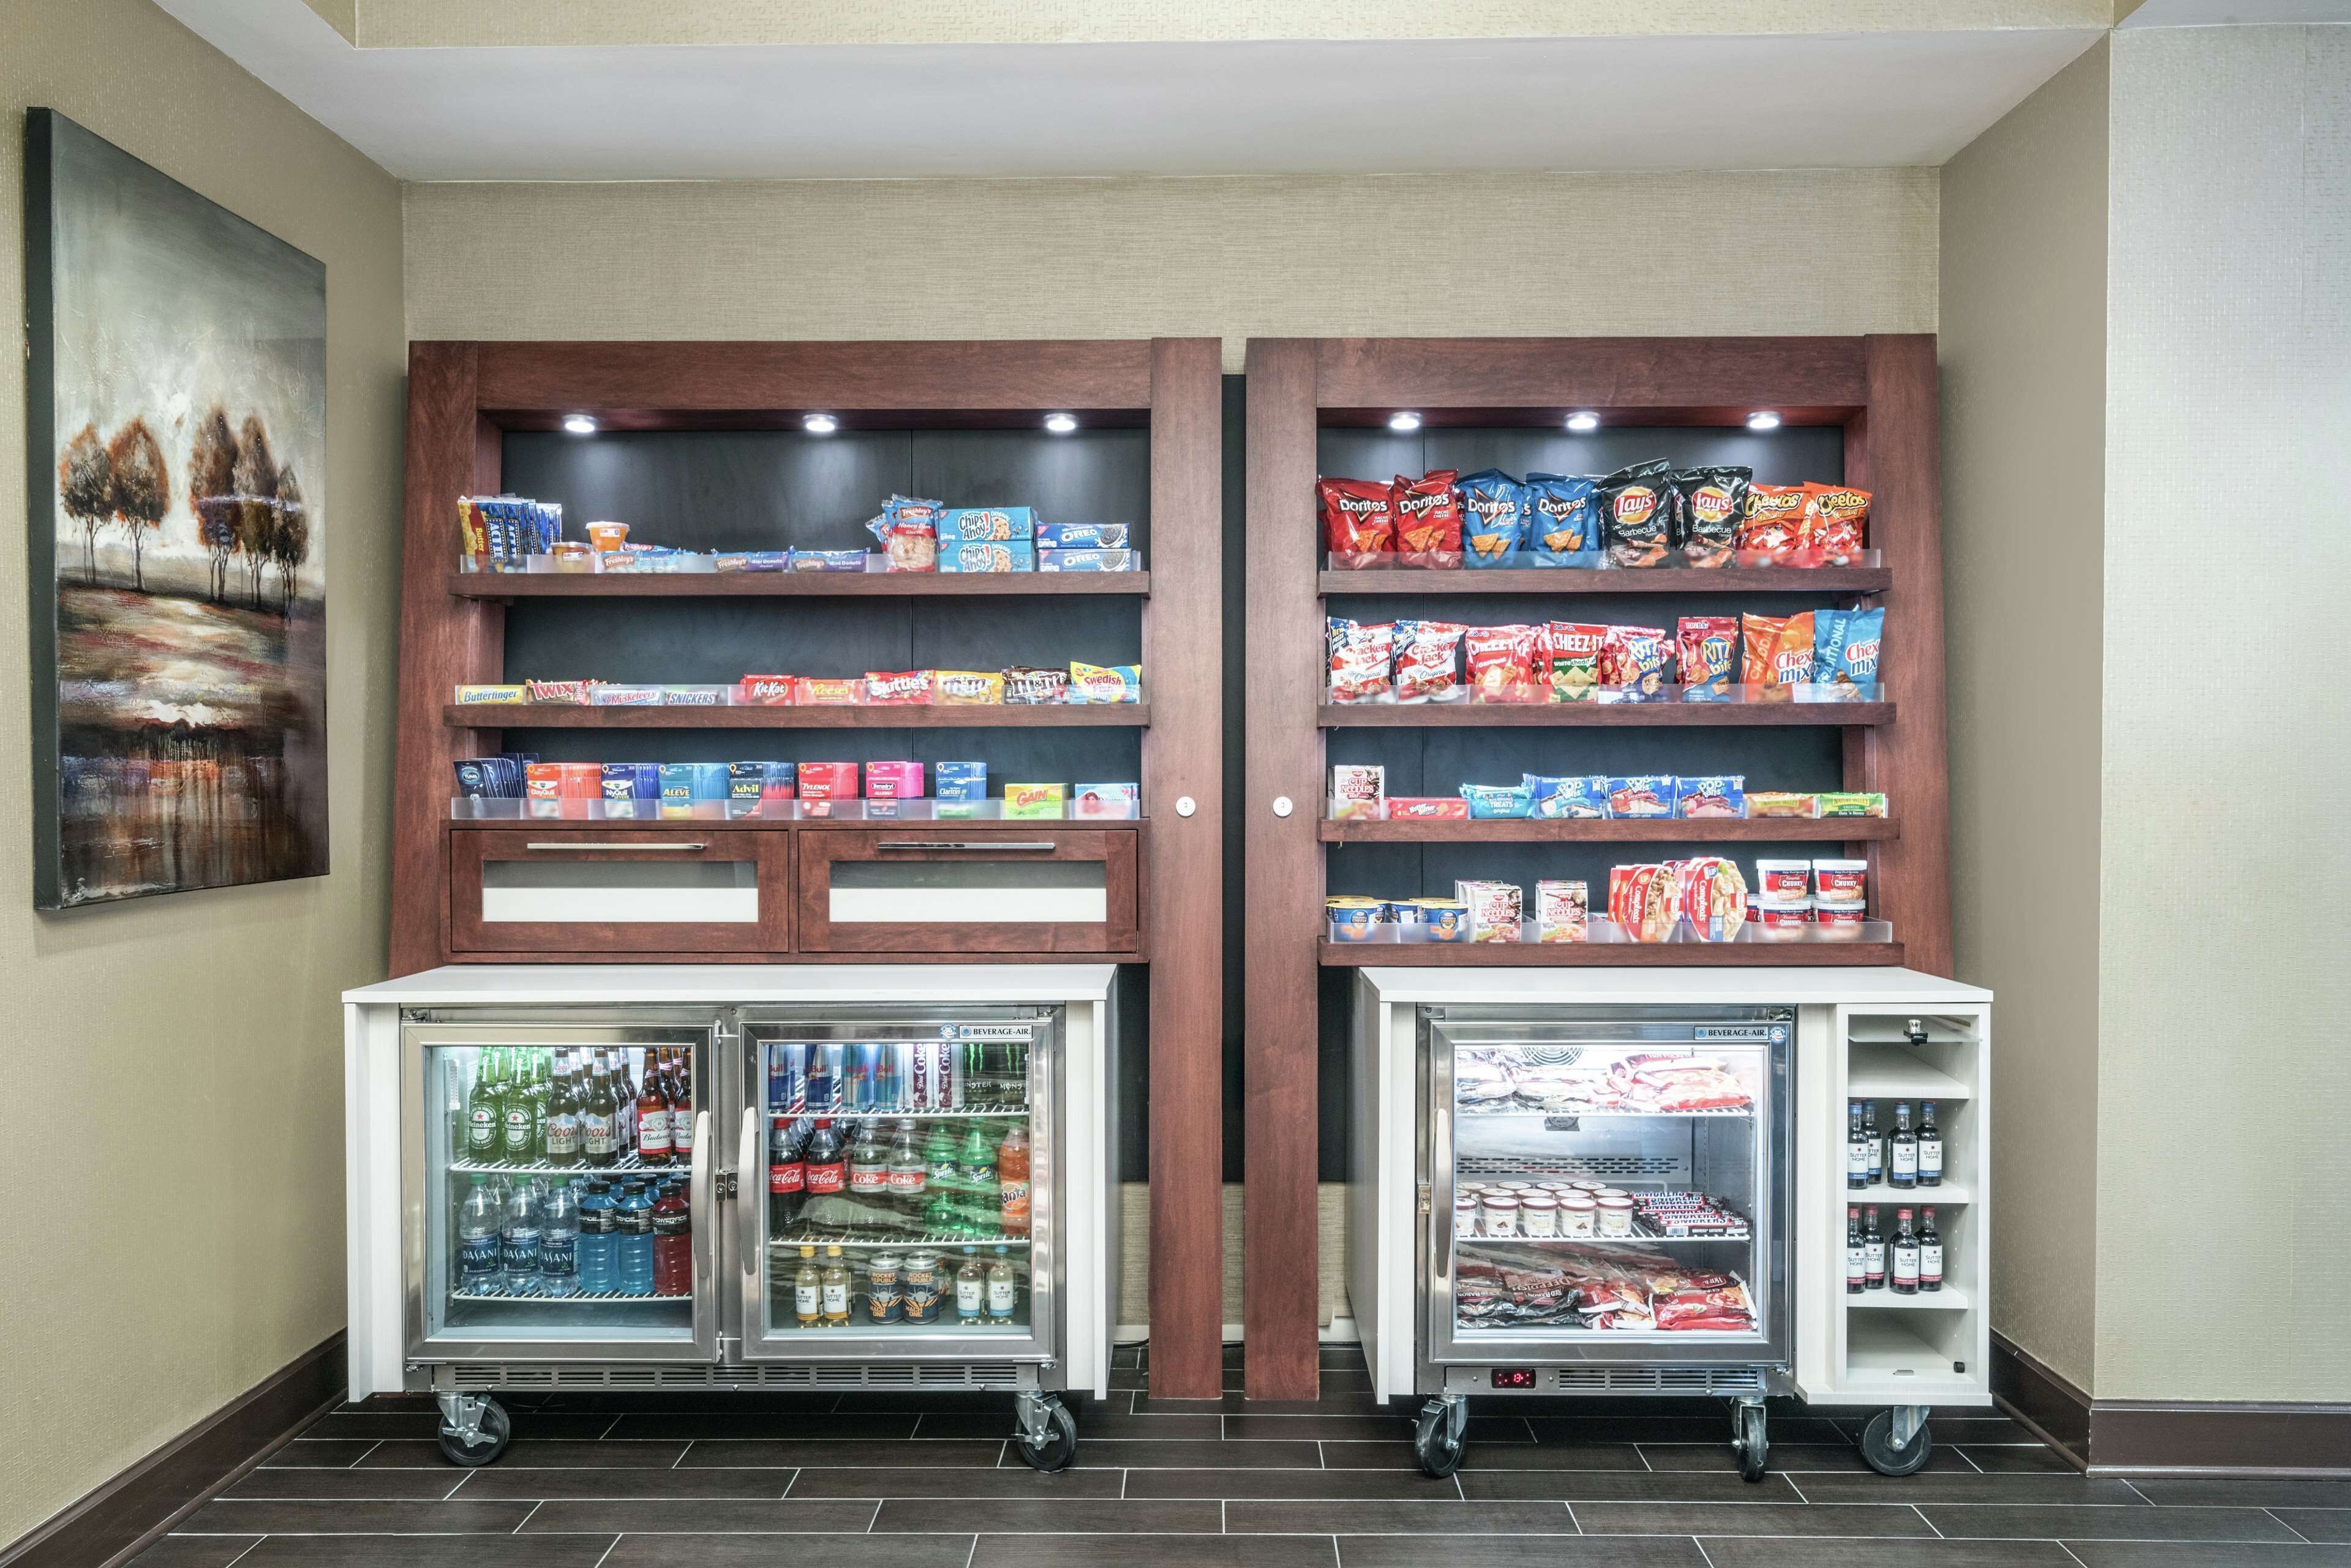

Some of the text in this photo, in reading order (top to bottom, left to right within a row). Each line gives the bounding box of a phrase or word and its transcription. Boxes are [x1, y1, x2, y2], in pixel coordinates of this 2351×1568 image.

[1339, 498, 1388, 512] Doritos
[1399, 493, 1450, 514] Doritos
[1467, 498, 1516, 513] Doritos
[1538, 497, 1586, 512] Doritos
[1618, 492, 1653, 516] Lay's
[1696, 492, 1730, 512] Lay's
[1745, 492, 1801, 518] Cheetos
[1818, 490, 1867, 516] Cheetos
[959, 513, 984, 531] Chips
[1060, 528, 1097, 543] OREO
[1619, 525, 1657, 538] Barbecue
[1692, 525, 1732, 534] Barbecue
[475, 528, 484, 552] Butter
[959, 546, 984, 563] Chips
[1063, 553, 1100, 568] OREO
[1702, 641, 1731, 663] RITZ
[1846, 639, 1881, 662] Chex
[1418, 652, 1444, 666] Jack
[1776, 649, 1813, 669] Chex
[1851, 655, 1878, 675] mix
[1709, 659, 1732, 675] bits
[1778, 664, 1811, 683] mix
[1083, 673, 1122, 686] Swedish
[1354, 670, 1382, 682] Original
[870, 675, 930, 697] Skittles
[464, 690, 519, 703] Butterfinger
[612, 690, 656, 704] Musketeers
[669, 692, 716, 705] SNICKERS
[662, 788, 690, 797] ALEVE
[732, 784, 759, 793] Advil
[939, 787, 961, 795] Claritin
[1340, 785, 1374, 795] NOODLES
[1016, 789, 1048, 807] GAIN
[1489, 901, 1509, 910] CUP
[1554, 901, 1574, 909] CUP
[1481, 909, 1516, 917] NOODLES
[1546, 908, 1581, 917] NOODLES
[914, 1043, 927, 1075] Coke
[939, 1043, 950, 1075] Coke
[878, 1065, 895, 1073] Bull
[853, 1173, 878, 1184] Coke
[890, 1174, 916, 1185] Coke
[933, 1167, 954, 1180] Sprite
[971, 1169, 992, 1183] Sprite
[463, 1247, 497, 1262] DASANI
[504, 1247, 537, 1261] DASANI
[541, 1251, 572, 1264] DASANI
